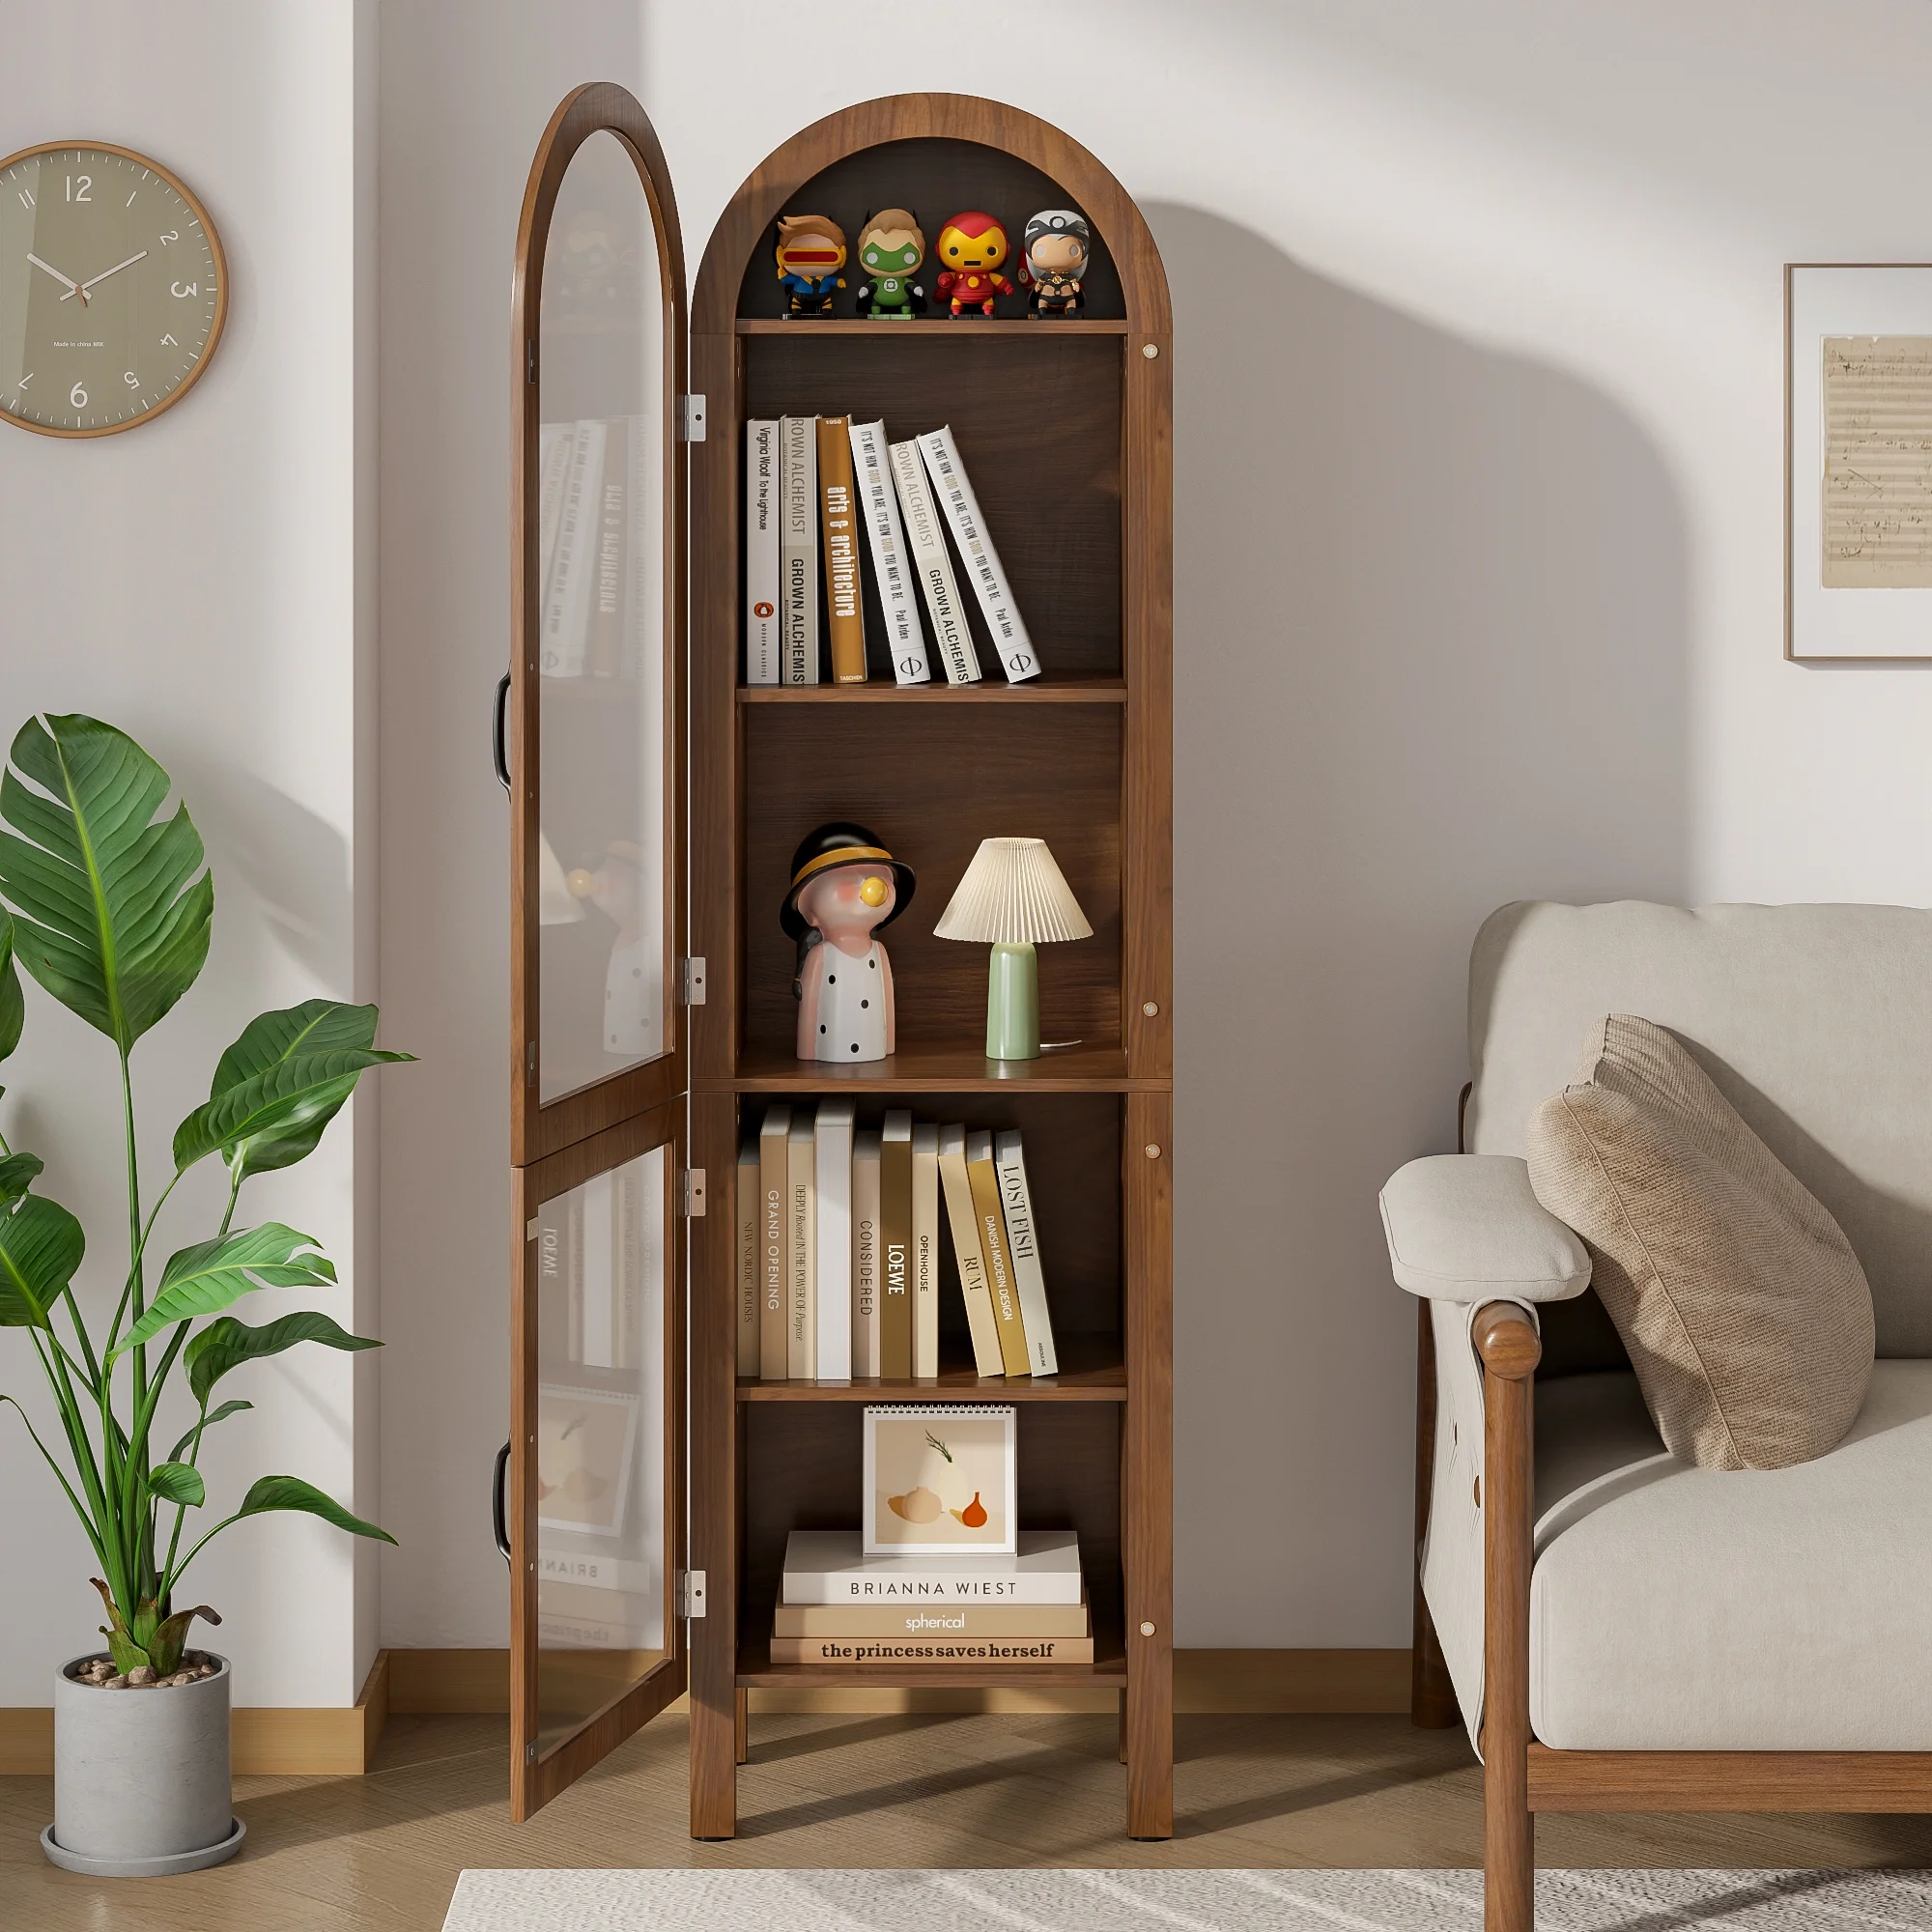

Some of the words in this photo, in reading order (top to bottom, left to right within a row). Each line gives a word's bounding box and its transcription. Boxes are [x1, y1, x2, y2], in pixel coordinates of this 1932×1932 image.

[66, 175, 93, 202] 12
[159, 230, 179, 246] 2
[170, 281, 197, 298] 3
[159, 332, 179, 347] 4
[18, 372, 35, 390] 7
[124, 371, 140, 389] 5
[70, 382, 88, 409] 6
[755, 426, 771, 455] Virginia
[860, 431, 873, 442] IT'S
[929, 438, 943, 450] IT'S
[863, 443, 876, 454] NOT
[934, 449, 948, 462] NOT
[758, 455, 771, 477] Woolf
[866, 455, 878, 469] HOW
[939, 461, 952, 474] HOW
[758, 488, 769, 498] the
[791, 462, 806, 535] ALCHEMIST
[827, 486, 850, 514] arts
[870, 485, 883, 497] YOU
[950, 489, 963, 502] YOU
[756, 498, 769, 530] Lighthouse
[876, 512, 889, 523] IT'S
[905, 483, 934, 547] ALCHEMIST
[959, 515, 973, 527] IT'S
[884, 554, 897, 565] YOU
[975, 554, 988, 567] YOU
[791, 558, 804, 610] GROWN
[831, 534, 857, 617] architecture
[887, 566, 900, 582] WANT
[980, 566, 995, 583] WANT
[985, 582, 998, 591] TO
[895, 610, 909, 623] Paul
[929, 569, 952, 616] GROWN
[942, 620, 969, 682] ALCHEMIS
[995, 608, 1009, 622] Paul
[897, 623, 911, 640] Arden
[1000, 621, 1013, 639] Arden
[792, 614, 806, 685] ALCHEMIS
[795, 1184, 807, 1214] DEEPLY
[1003, 1166, 1027, 1213] LOST
[768, 1190, 780, 1239] GRAND
[744, 1221, 753, 1243] NEW
[795, 1214, 807, 1240] Rooted
[984, 1215, 1000, 1249] DANISH
[795, 1240, 807, 1250] IN
[1011, 1217, 1034, 1260] FISH
[743, 1246, 753, 1285] NORDIC
[795, 1252, 807, 1267] THE
[860, 1220, 873, 1316] CONSIDERED
[888, 1244, 905, 1295] LOEWE
[920, 1236, 928, 1293] OPENHOUSE
[991, 1249, 1008, 1288] MODERN
[768, 1245, 780, 1310] OPENING
[795, 1269, 807, 1298] POWER
[964, 1257, 983, 1291] RUM
[743, 1287, 753, 1322] HOUSES
[795, 1299, 807, 1311] OF
[998, 1288, 1013, 1321] DESIGN
[793, 1312, 807, 1343] Purpose.
[850, 1582, 945, 1595] BRIANNA
[955, 1582, 1016, 1595] WIEST
[905, 1612, 965, 1633] spherical
[821, 1643, 852, 1658] the
[855, 1643, 934, 1661] princess
[935, 1646, 986, 1658] saves
[988, 1643, 1055, 1658] herself
